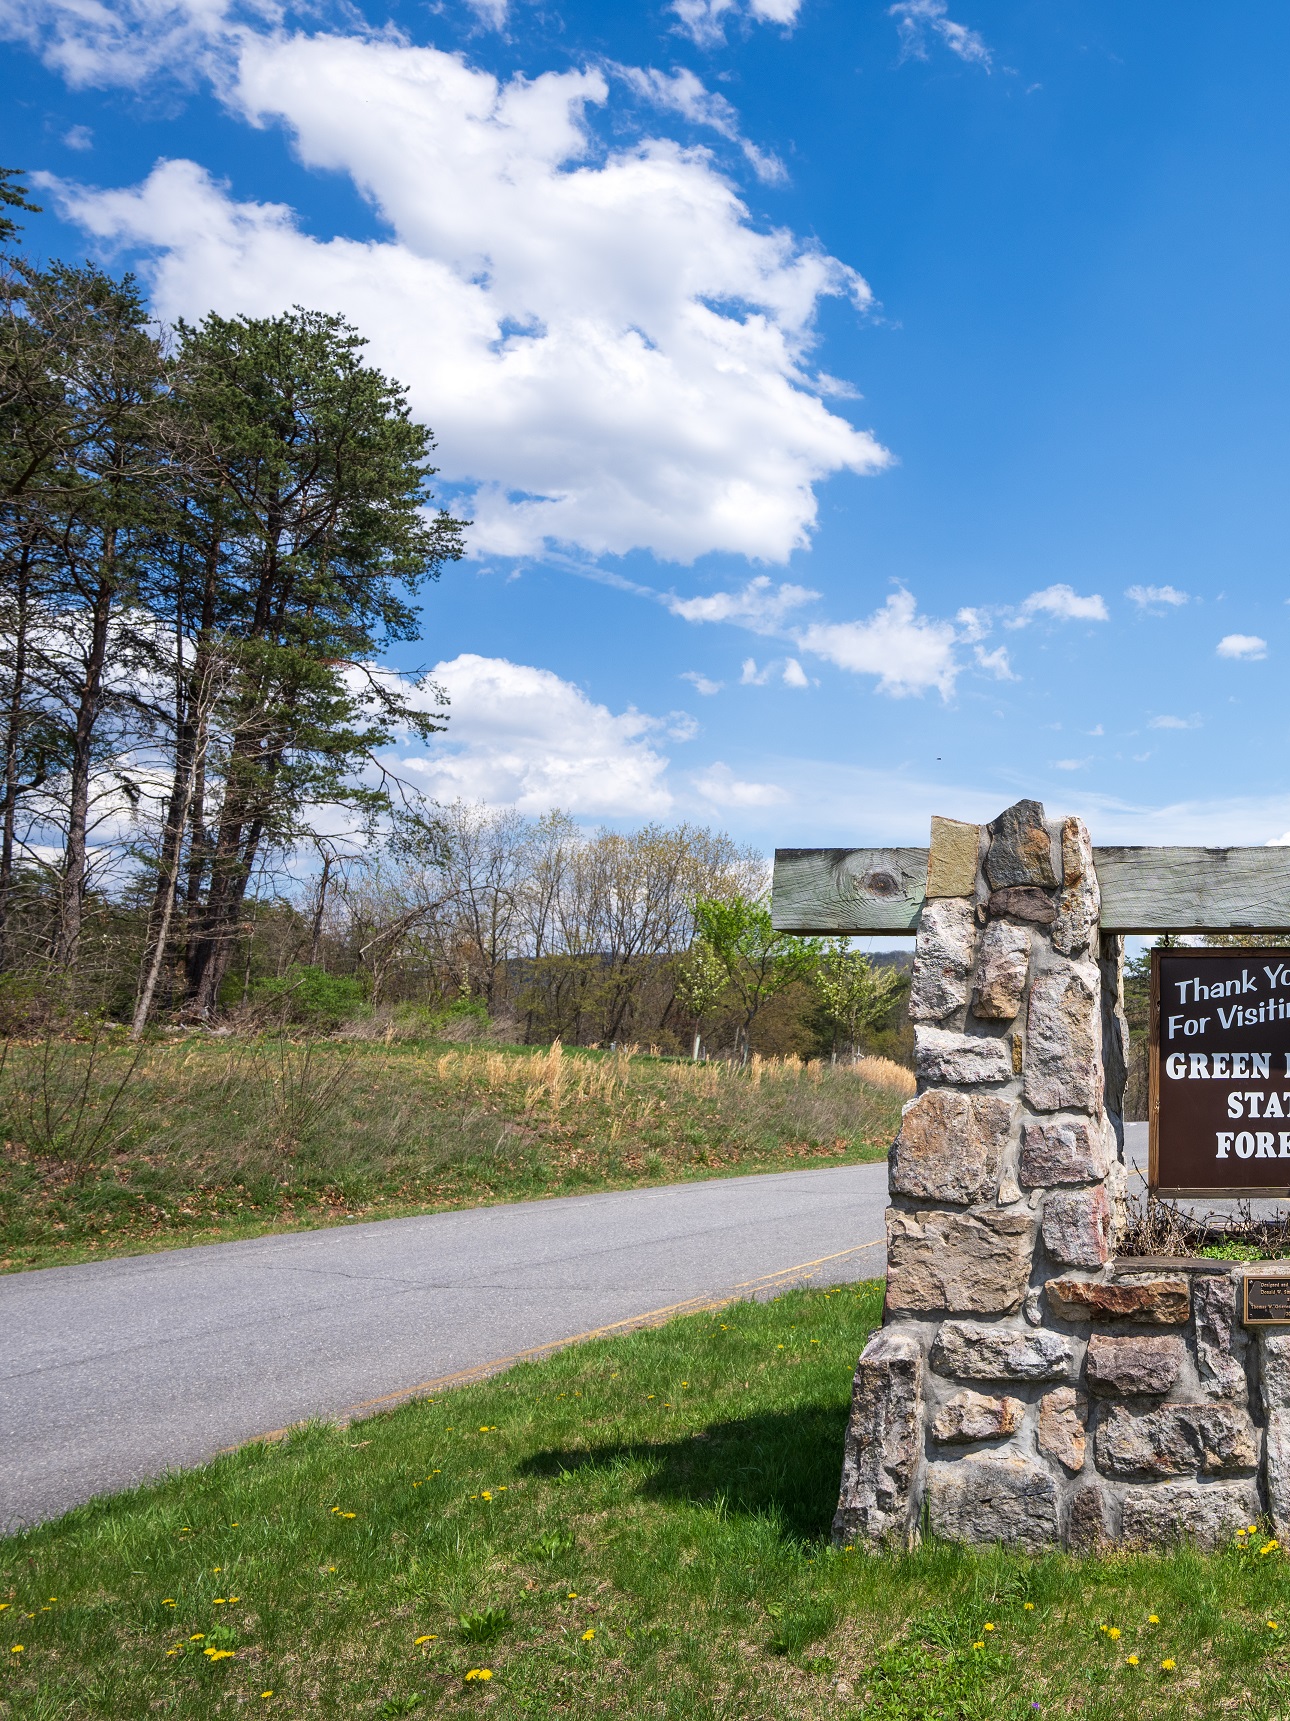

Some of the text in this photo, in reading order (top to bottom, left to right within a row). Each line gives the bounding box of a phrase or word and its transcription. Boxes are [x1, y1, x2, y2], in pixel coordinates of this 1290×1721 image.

[1174, 969, 1258, 1005] Thank
[1168, 1014, 1211, 1040] For
[1165, 1052, 1272, 1080] GREEN
